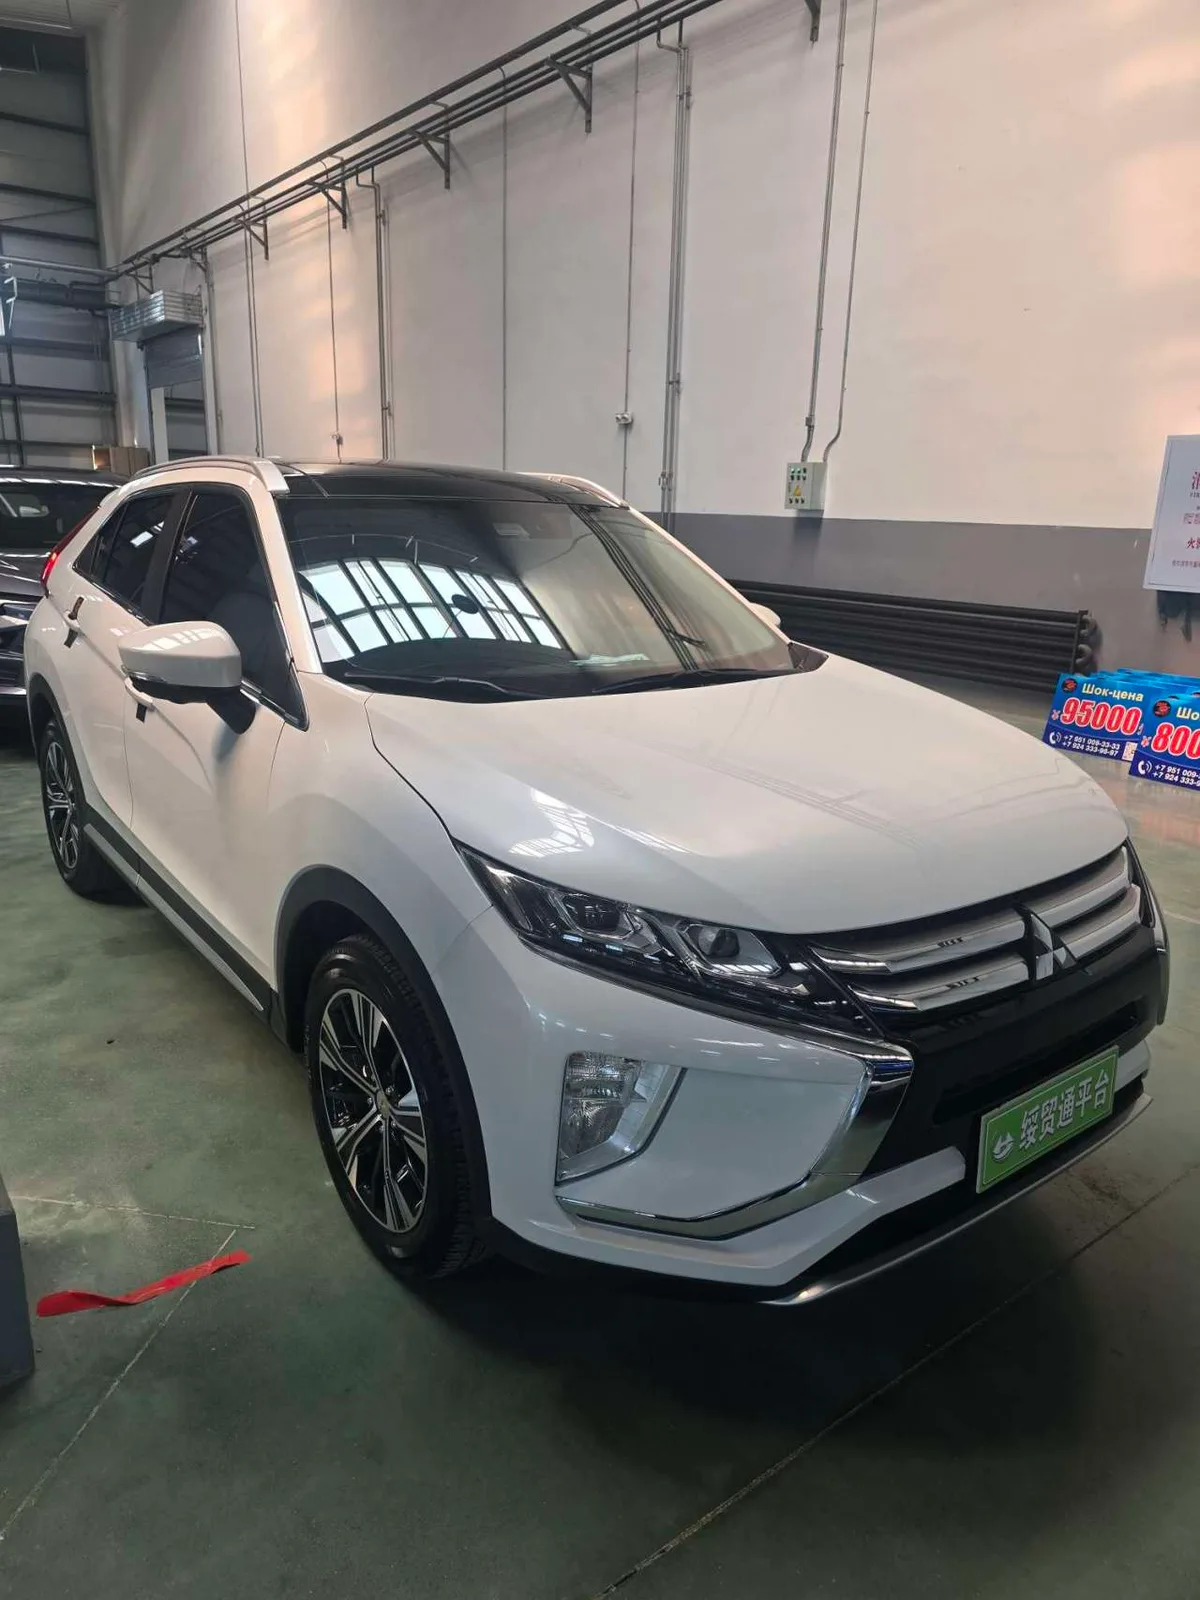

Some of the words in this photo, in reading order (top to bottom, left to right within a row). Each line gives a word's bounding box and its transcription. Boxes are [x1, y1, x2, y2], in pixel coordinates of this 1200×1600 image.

[1082, 683, 1144, 702] Шок-цена
[1060, 697, 1142, 735] 95000
[1164, 773, 1179, 782] 924
[1167, 766, 1180, 774] 951
[1019, 1069, 1110, 1149] 绥贸通平台
